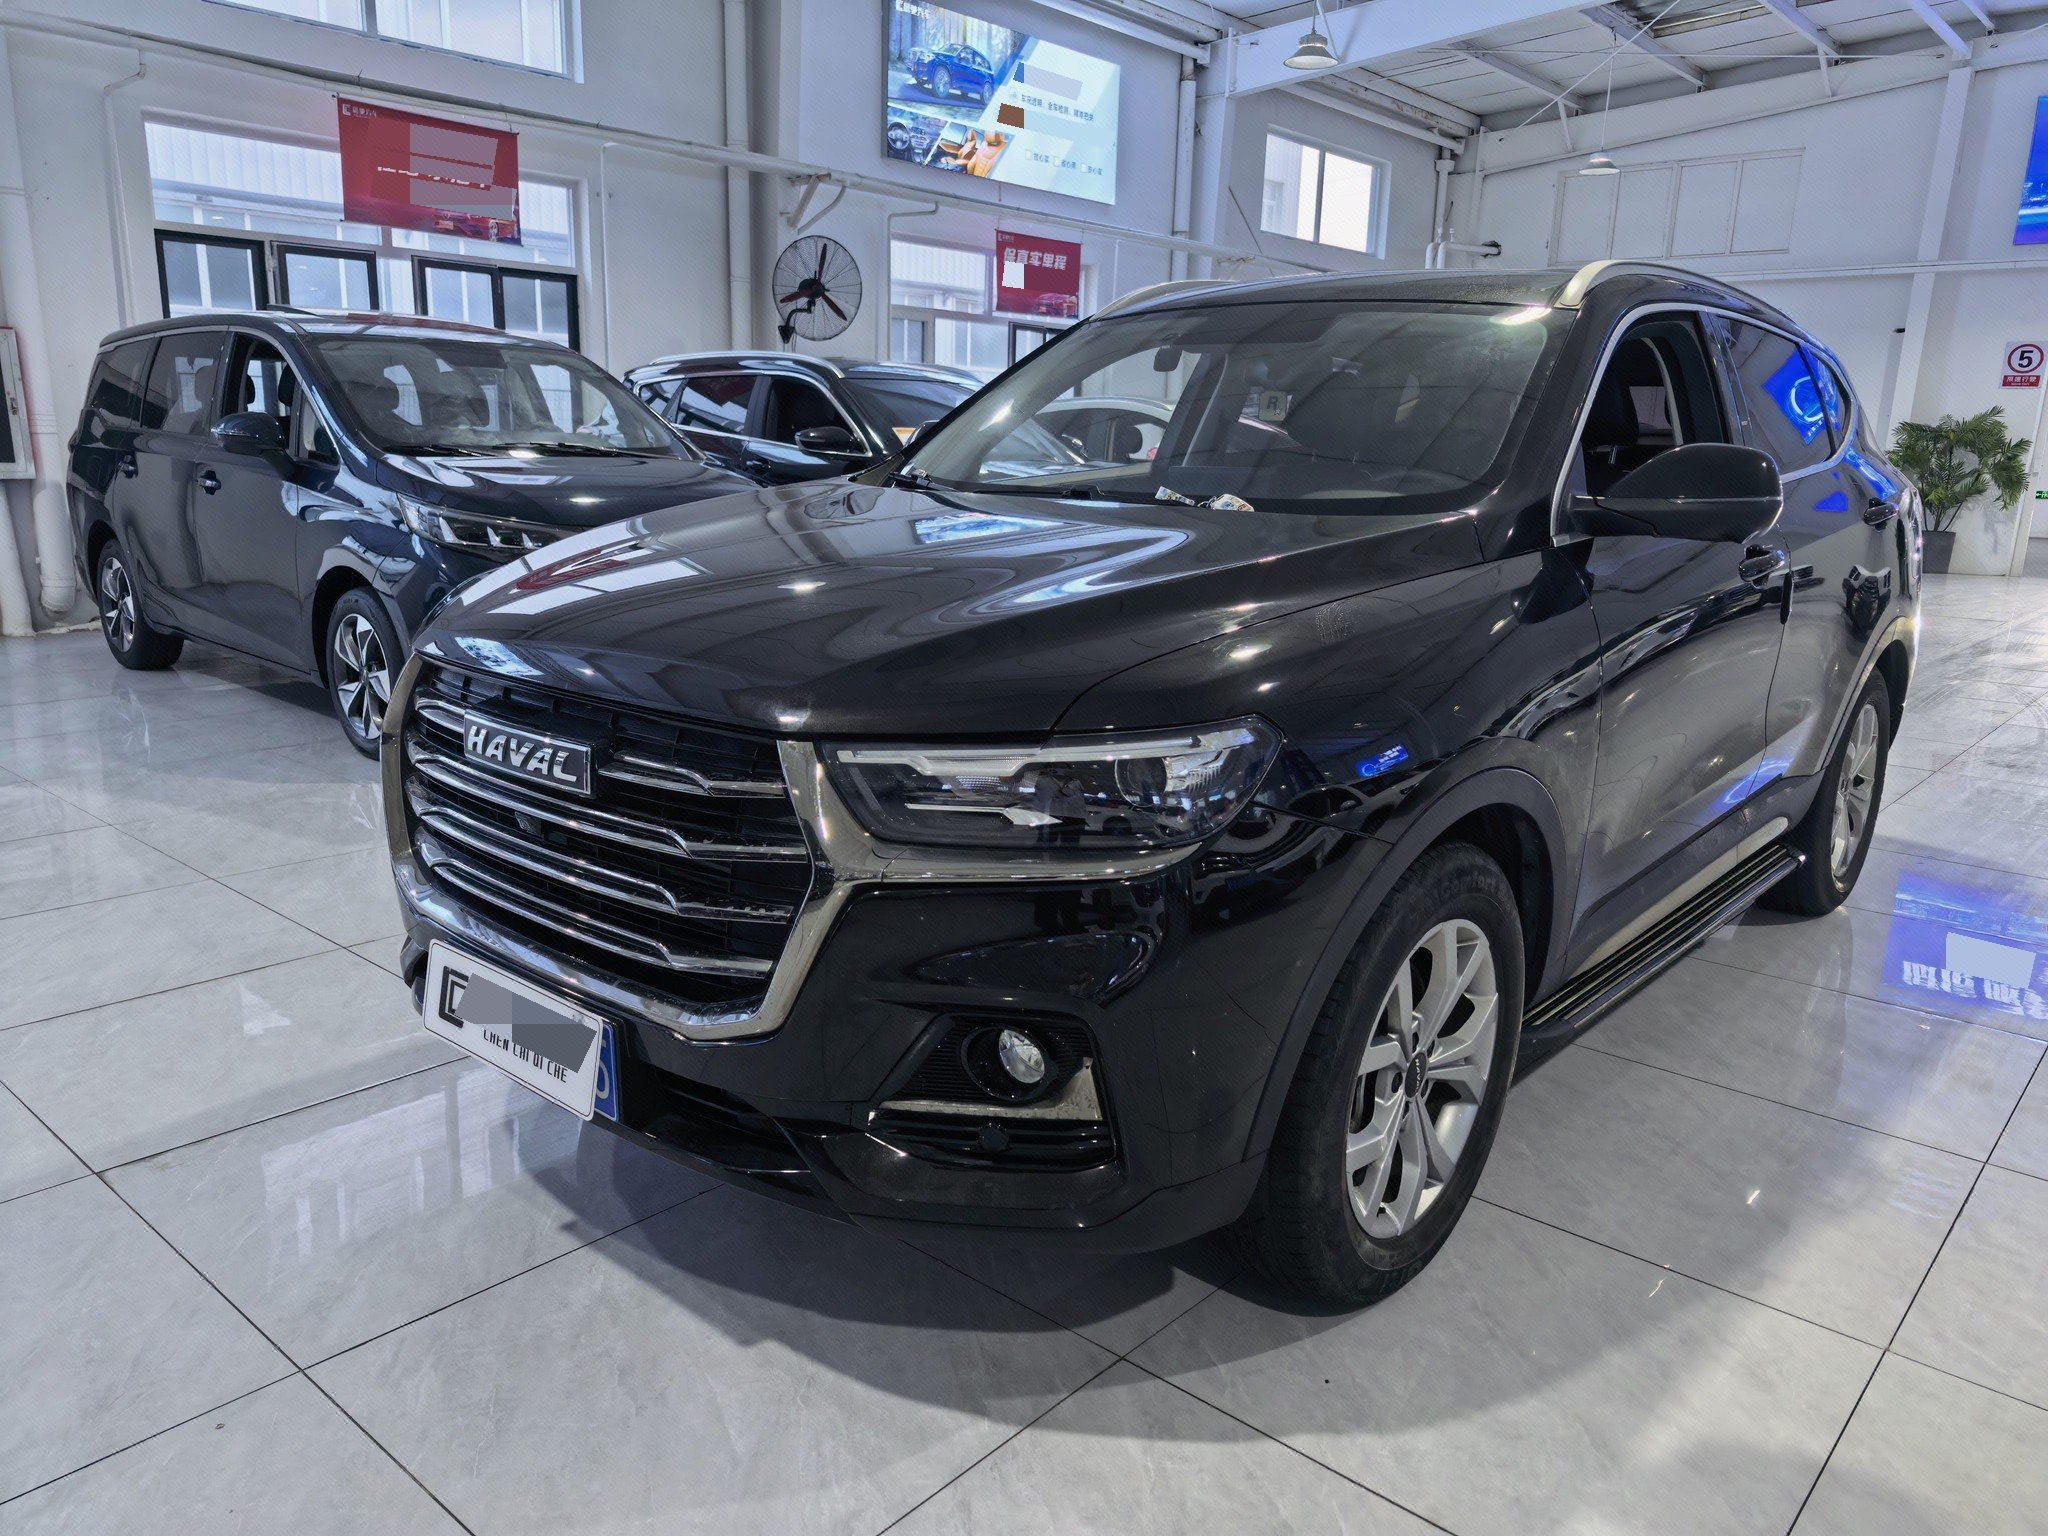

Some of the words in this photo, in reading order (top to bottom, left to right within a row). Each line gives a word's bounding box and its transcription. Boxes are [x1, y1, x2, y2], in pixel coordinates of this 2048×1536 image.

[1004, 246, 1067, 271] 保真实里程
[2018, 350, 2034, 368] 5
[467, 725, 577, 782] HAVAL
[483, 1029, 510, 1052] CHEN
[546, 1060, 568, 1084] CHE
